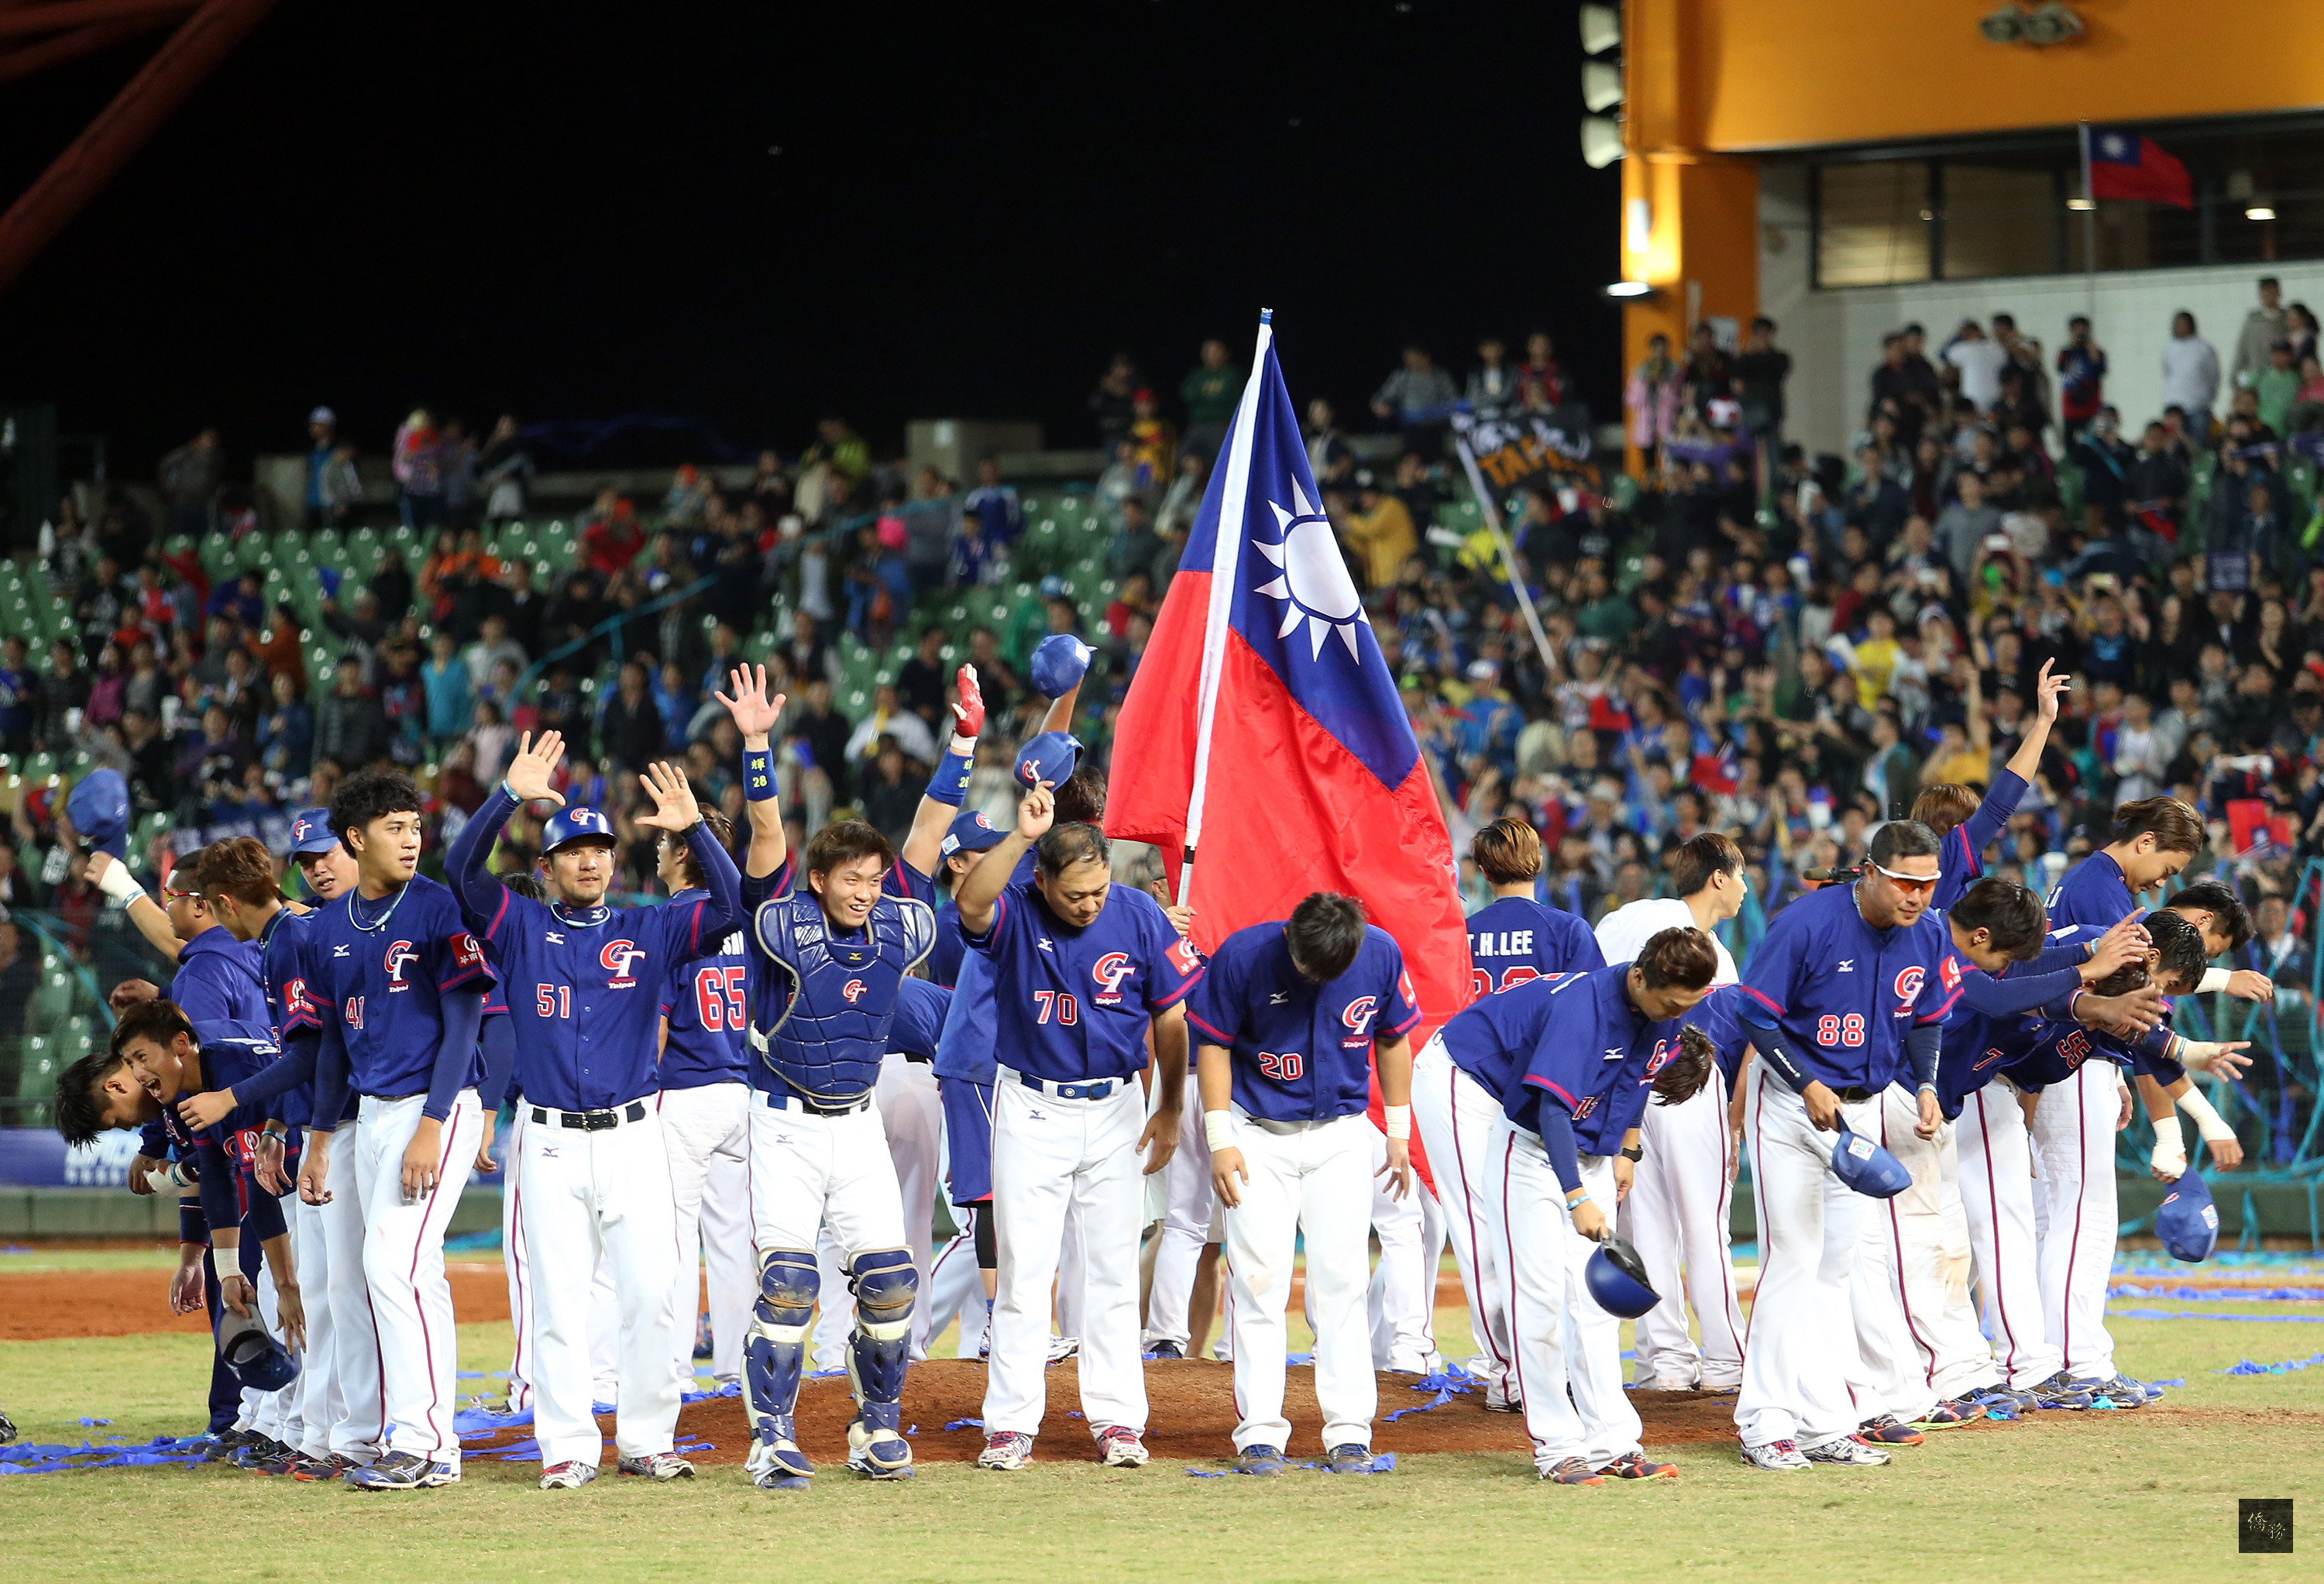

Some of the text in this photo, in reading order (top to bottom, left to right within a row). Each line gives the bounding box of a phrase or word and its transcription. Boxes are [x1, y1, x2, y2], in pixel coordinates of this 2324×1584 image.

[752, 775, 767, 788] 28
[600, 939, 646, 978] CT
[1092, 951, 1136, 993] CT
[536, 983, 571, 1019] 51
[608, 981, 637, 989] Taipei
[695, 965, 746, 1033] 65
[1095, 997, 1122, 1006] Taipei
[346, 996, 365, 1030] 41
[1034, 991, 1078, 1026] 70
[1342, 995, 1379, 1035] CT
[1342, 1039, 1369, 1049] Taipei
[1817, 1013, 1865, 1046] 88
[1258, 1051, 1304, 1081] 20
[2056, 1029, 2092, 1070] 55
